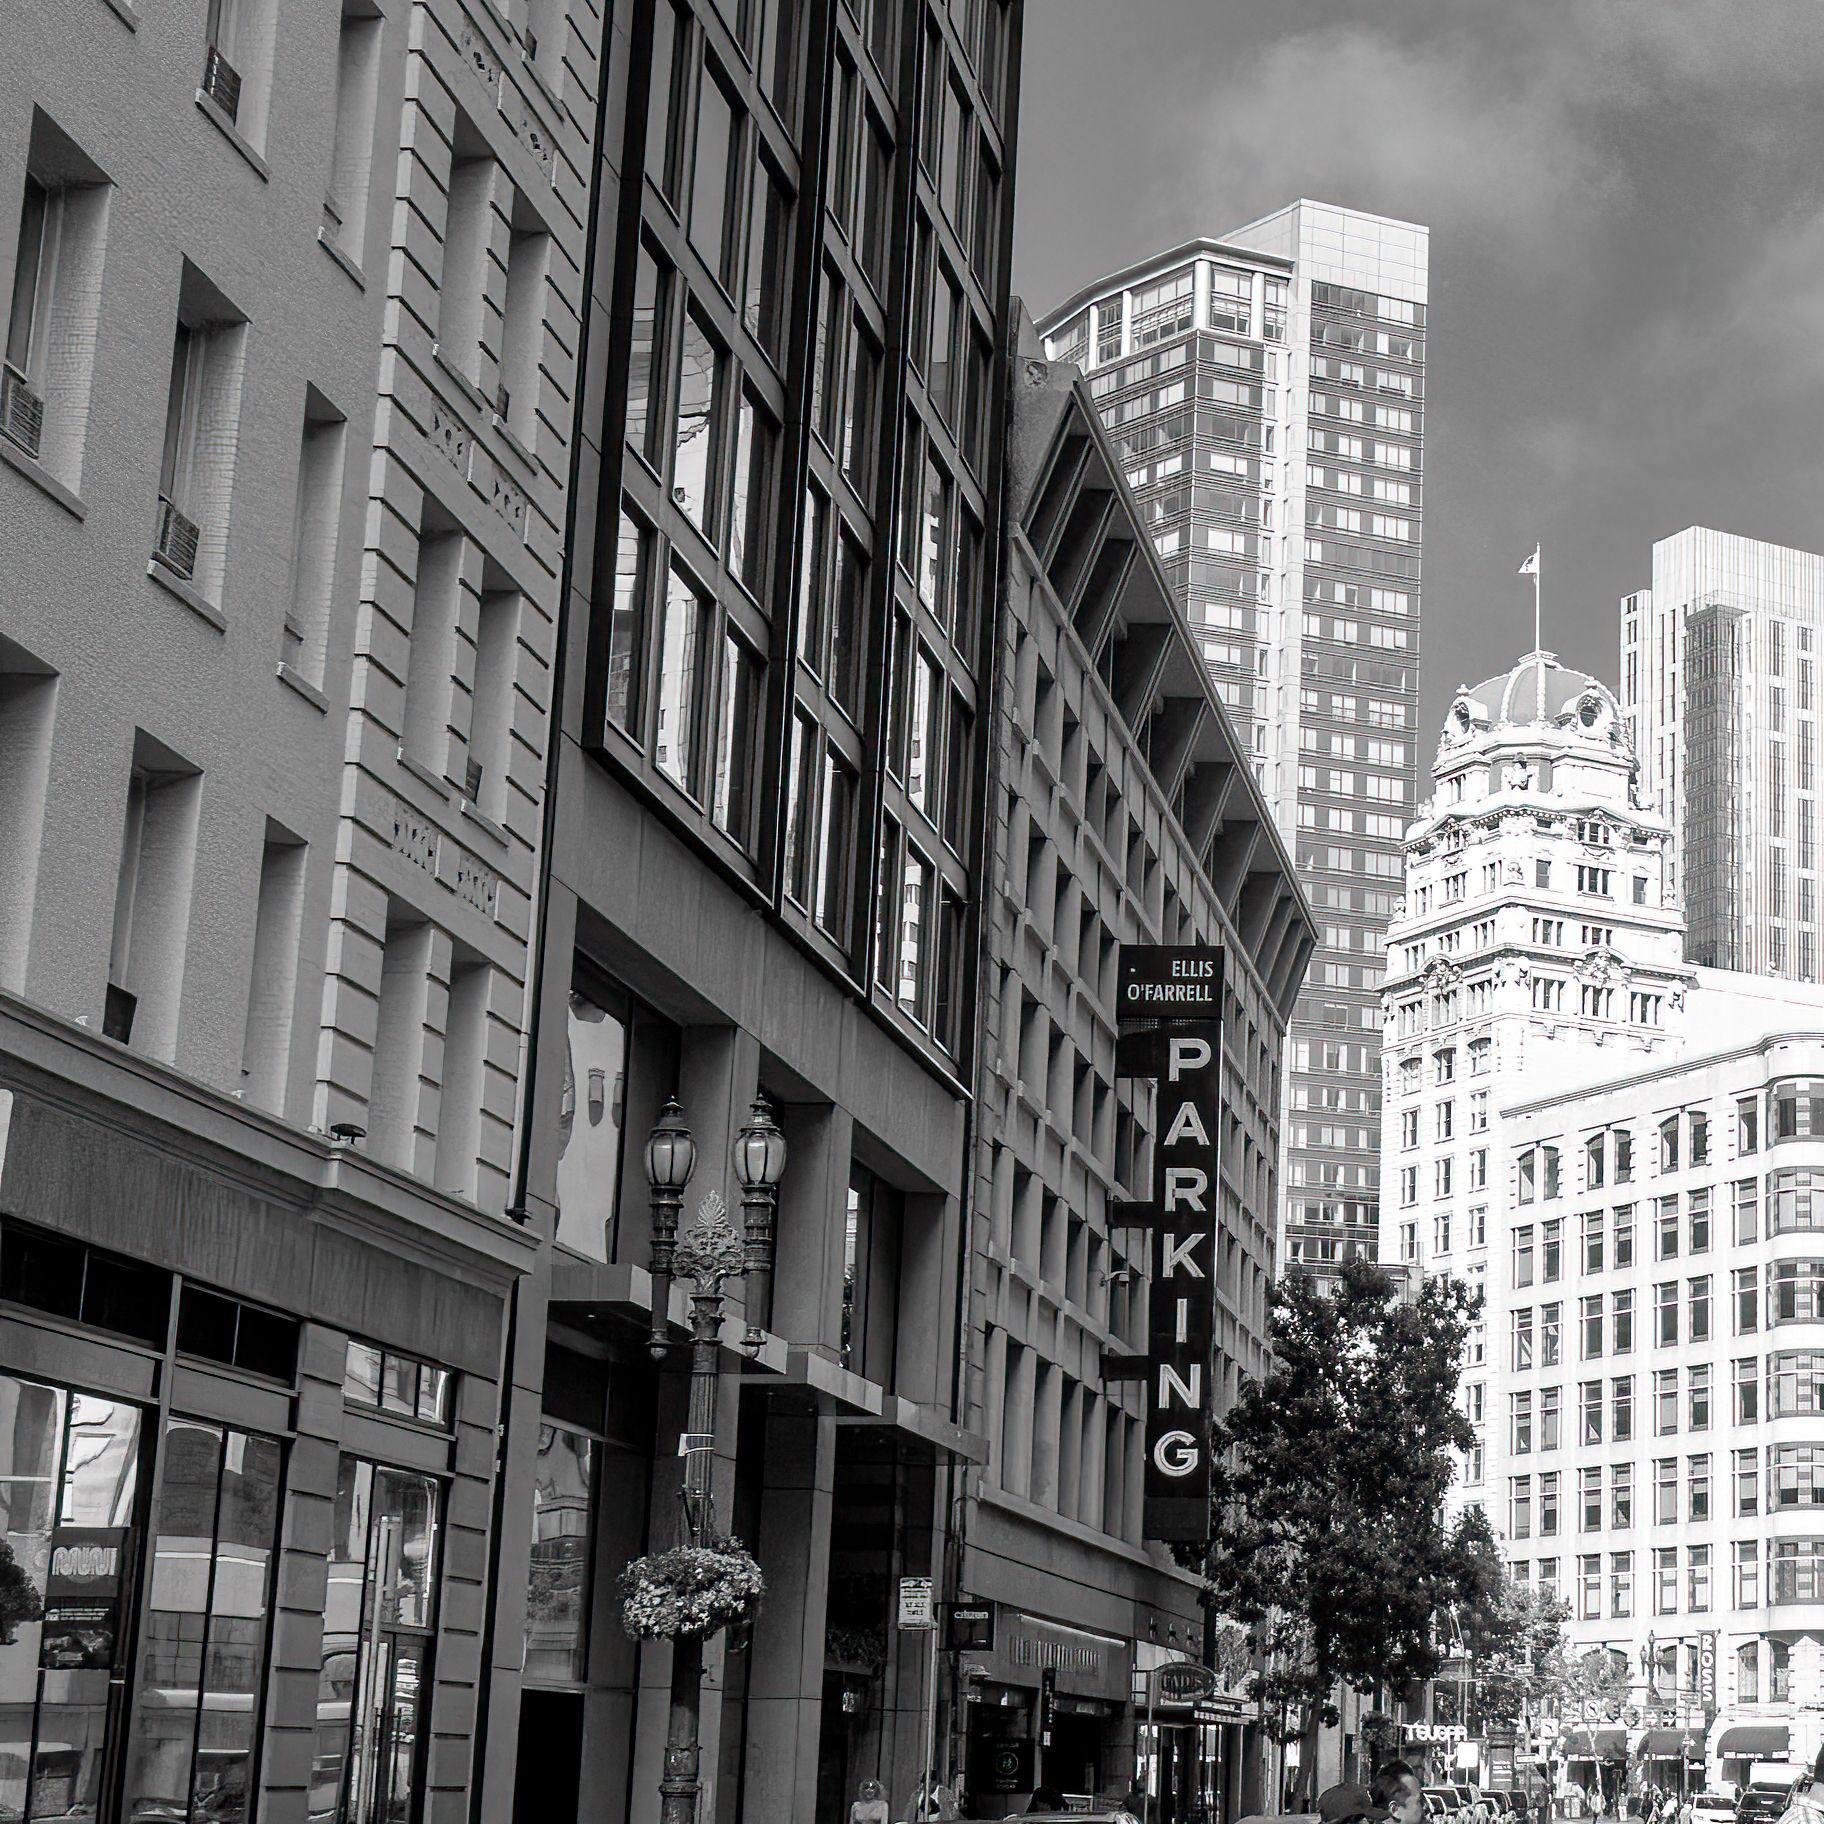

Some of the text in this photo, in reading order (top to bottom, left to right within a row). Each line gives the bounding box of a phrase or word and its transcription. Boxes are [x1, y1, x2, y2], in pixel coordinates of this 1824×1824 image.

[1171, 960, 1214, 977] ELLIS
[1127, 983, 1213, 1002] O'FARRELL
[1154, 1037, 1213, 1477] PARKING
[1701, 1634, 1714, 1702] ROSS
